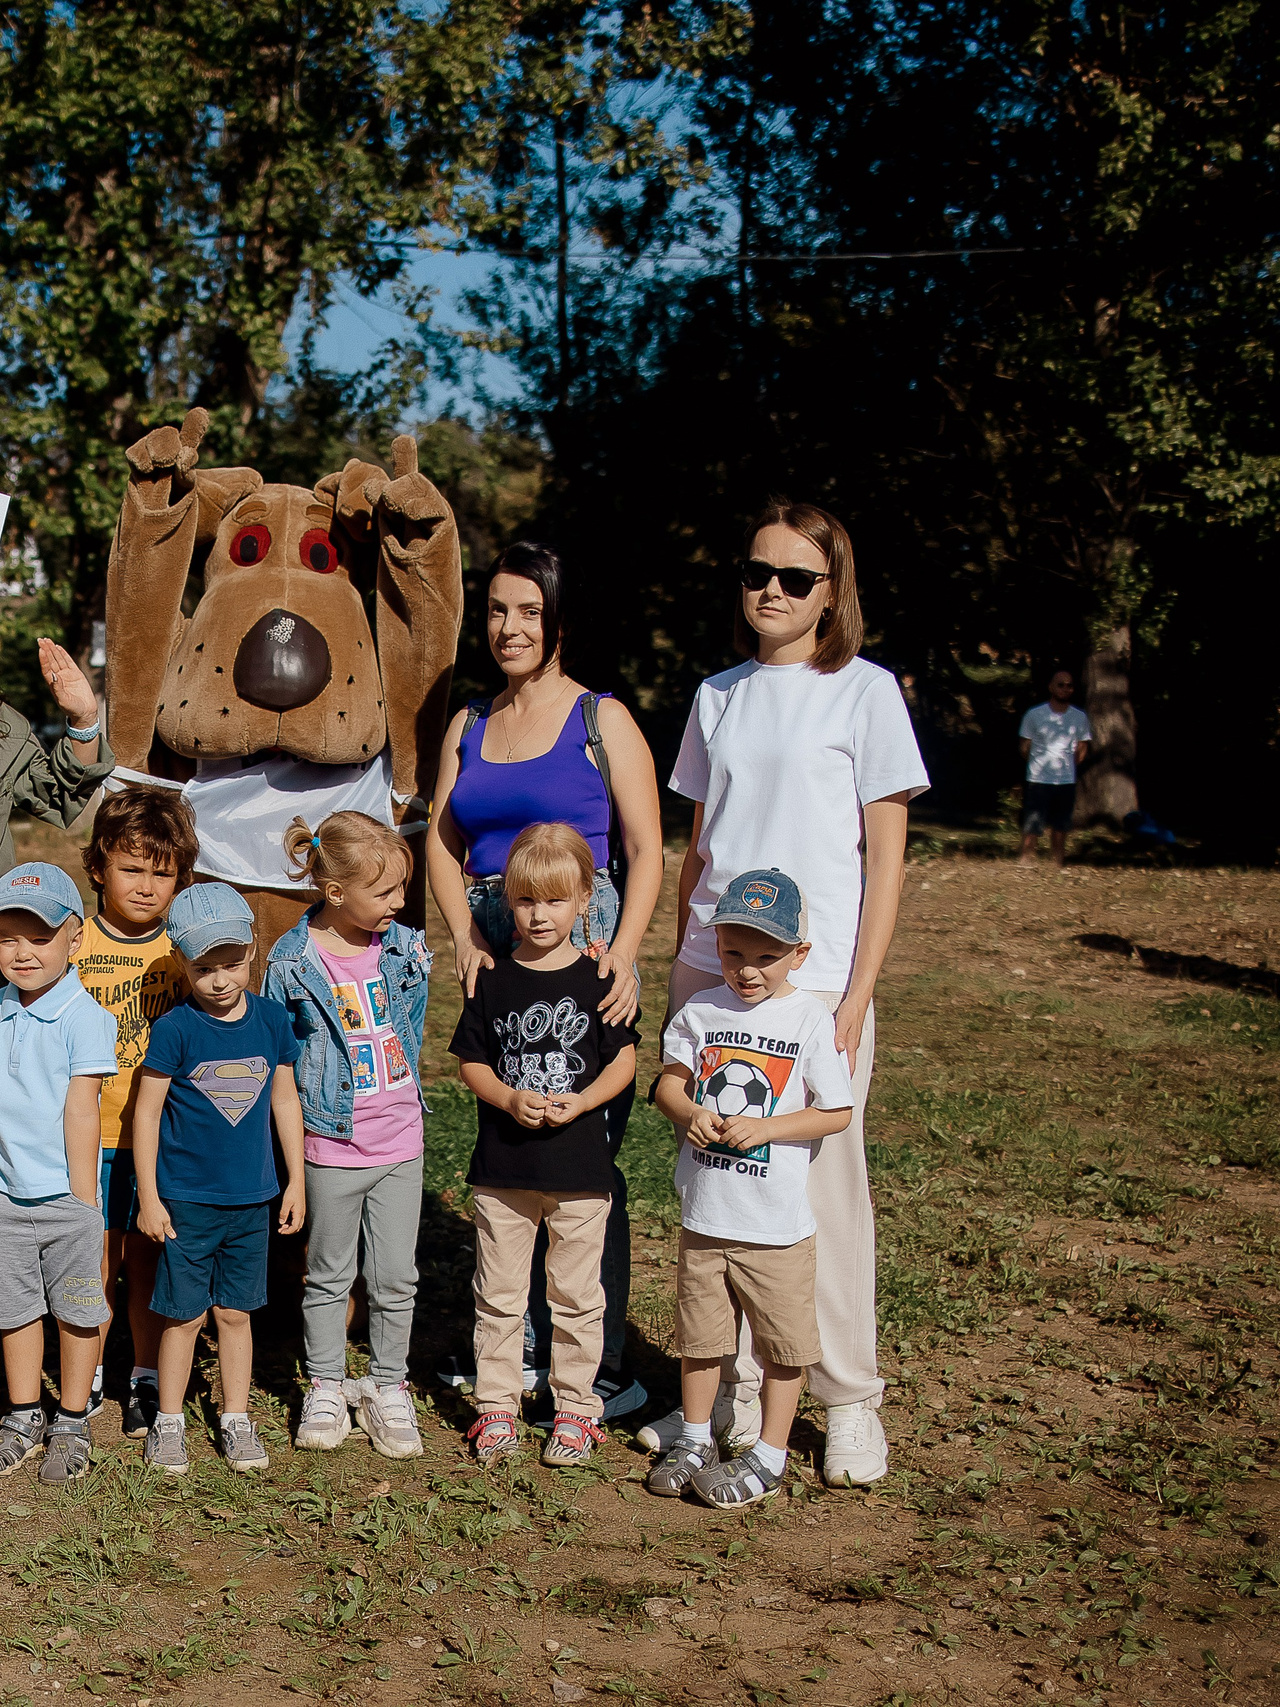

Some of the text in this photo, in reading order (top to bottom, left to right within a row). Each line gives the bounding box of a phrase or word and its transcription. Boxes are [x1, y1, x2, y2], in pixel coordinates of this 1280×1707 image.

[13, 877, 38, 885] DIESEL
[105, 971, 167, 1006] LARGEST
[705, 1031, 800, 1055] WORLD TEAM
[703, 1050, 721, 1067] W
[736, 1161, 768, 1178] ONE
[63, 1293, 103, 1306] FISHING
